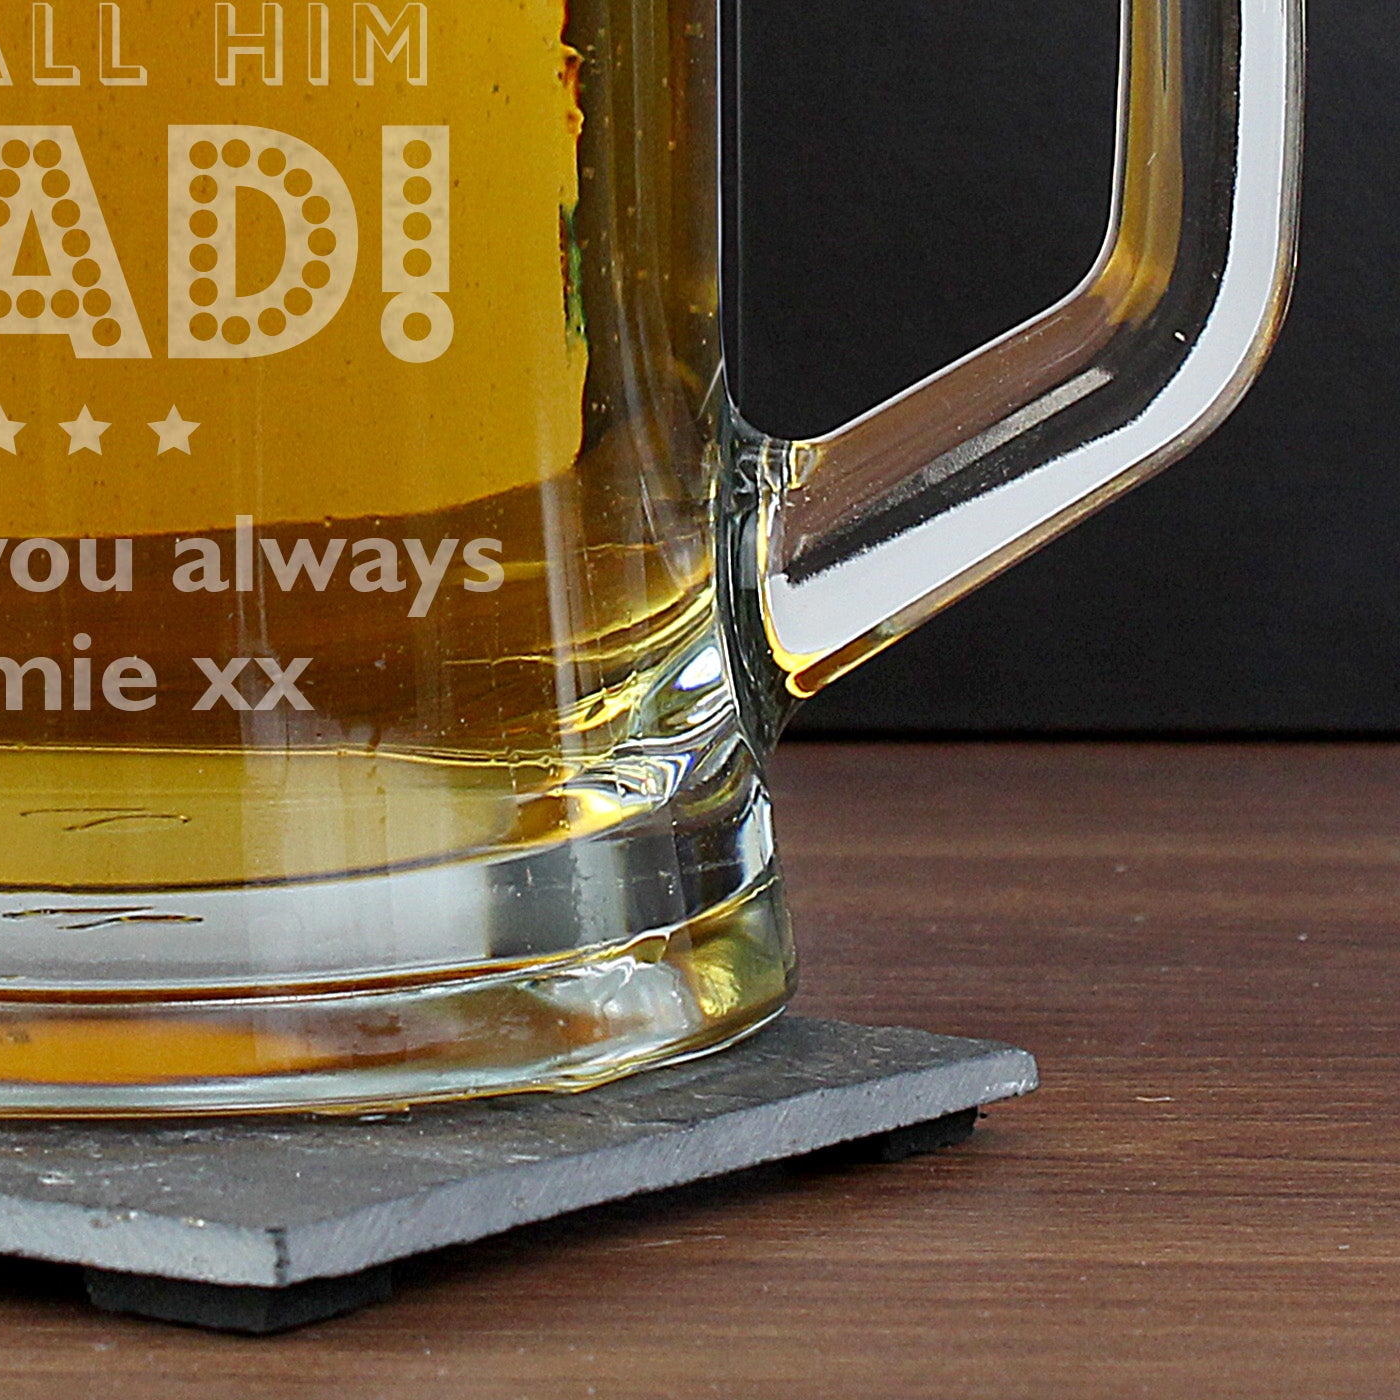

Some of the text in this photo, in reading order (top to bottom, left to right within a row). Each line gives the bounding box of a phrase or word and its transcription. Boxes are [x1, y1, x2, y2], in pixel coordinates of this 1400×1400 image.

[213, 1, 430, 86] HIM
[171, 513, 506, 619] always
[191, 656, 316, 712] xx
